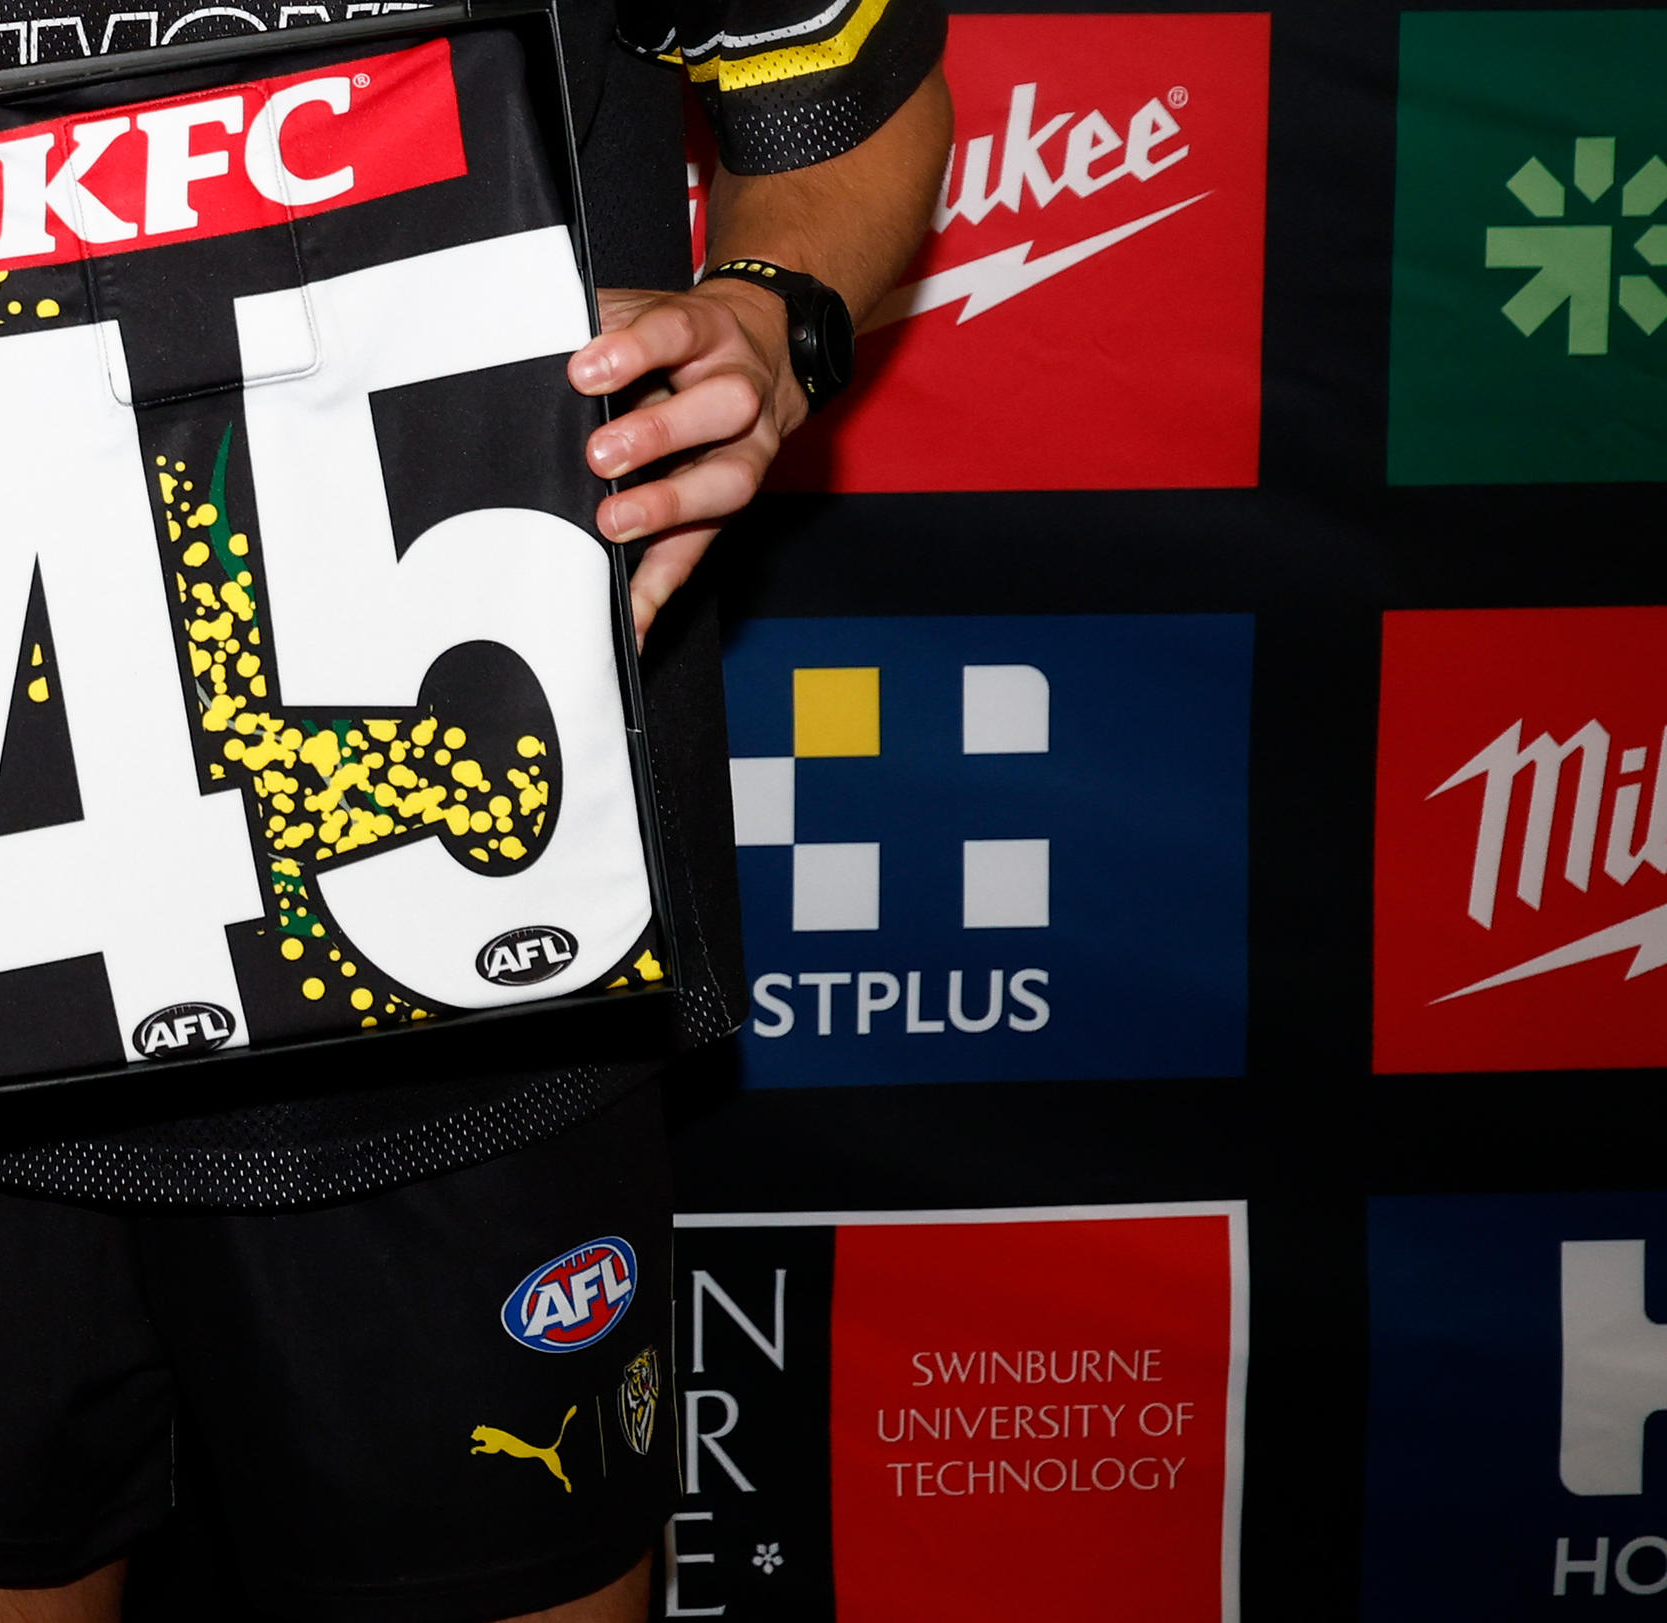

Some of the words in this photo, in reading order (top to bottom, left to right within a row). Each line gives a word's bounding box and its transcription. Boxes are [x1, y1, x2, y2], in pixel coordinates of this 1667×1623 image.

[486, 935, 572, 978] AFL
[752, 968, 1051, 1038] STPLUS
[143, 1012, 230, 1054] AFL
[522, 1253, 633, 1337] AFL
[912, 1348, 1162, 1387] SWINBURNE
[877, 1403, 1126, 1442] UNIVERSITY
[1138, 1401, 1195, 1437] OF
[886, 1456, 1187, 1498] TECHNOLOGY
[1553, 1534, 1667, 1596] HO
